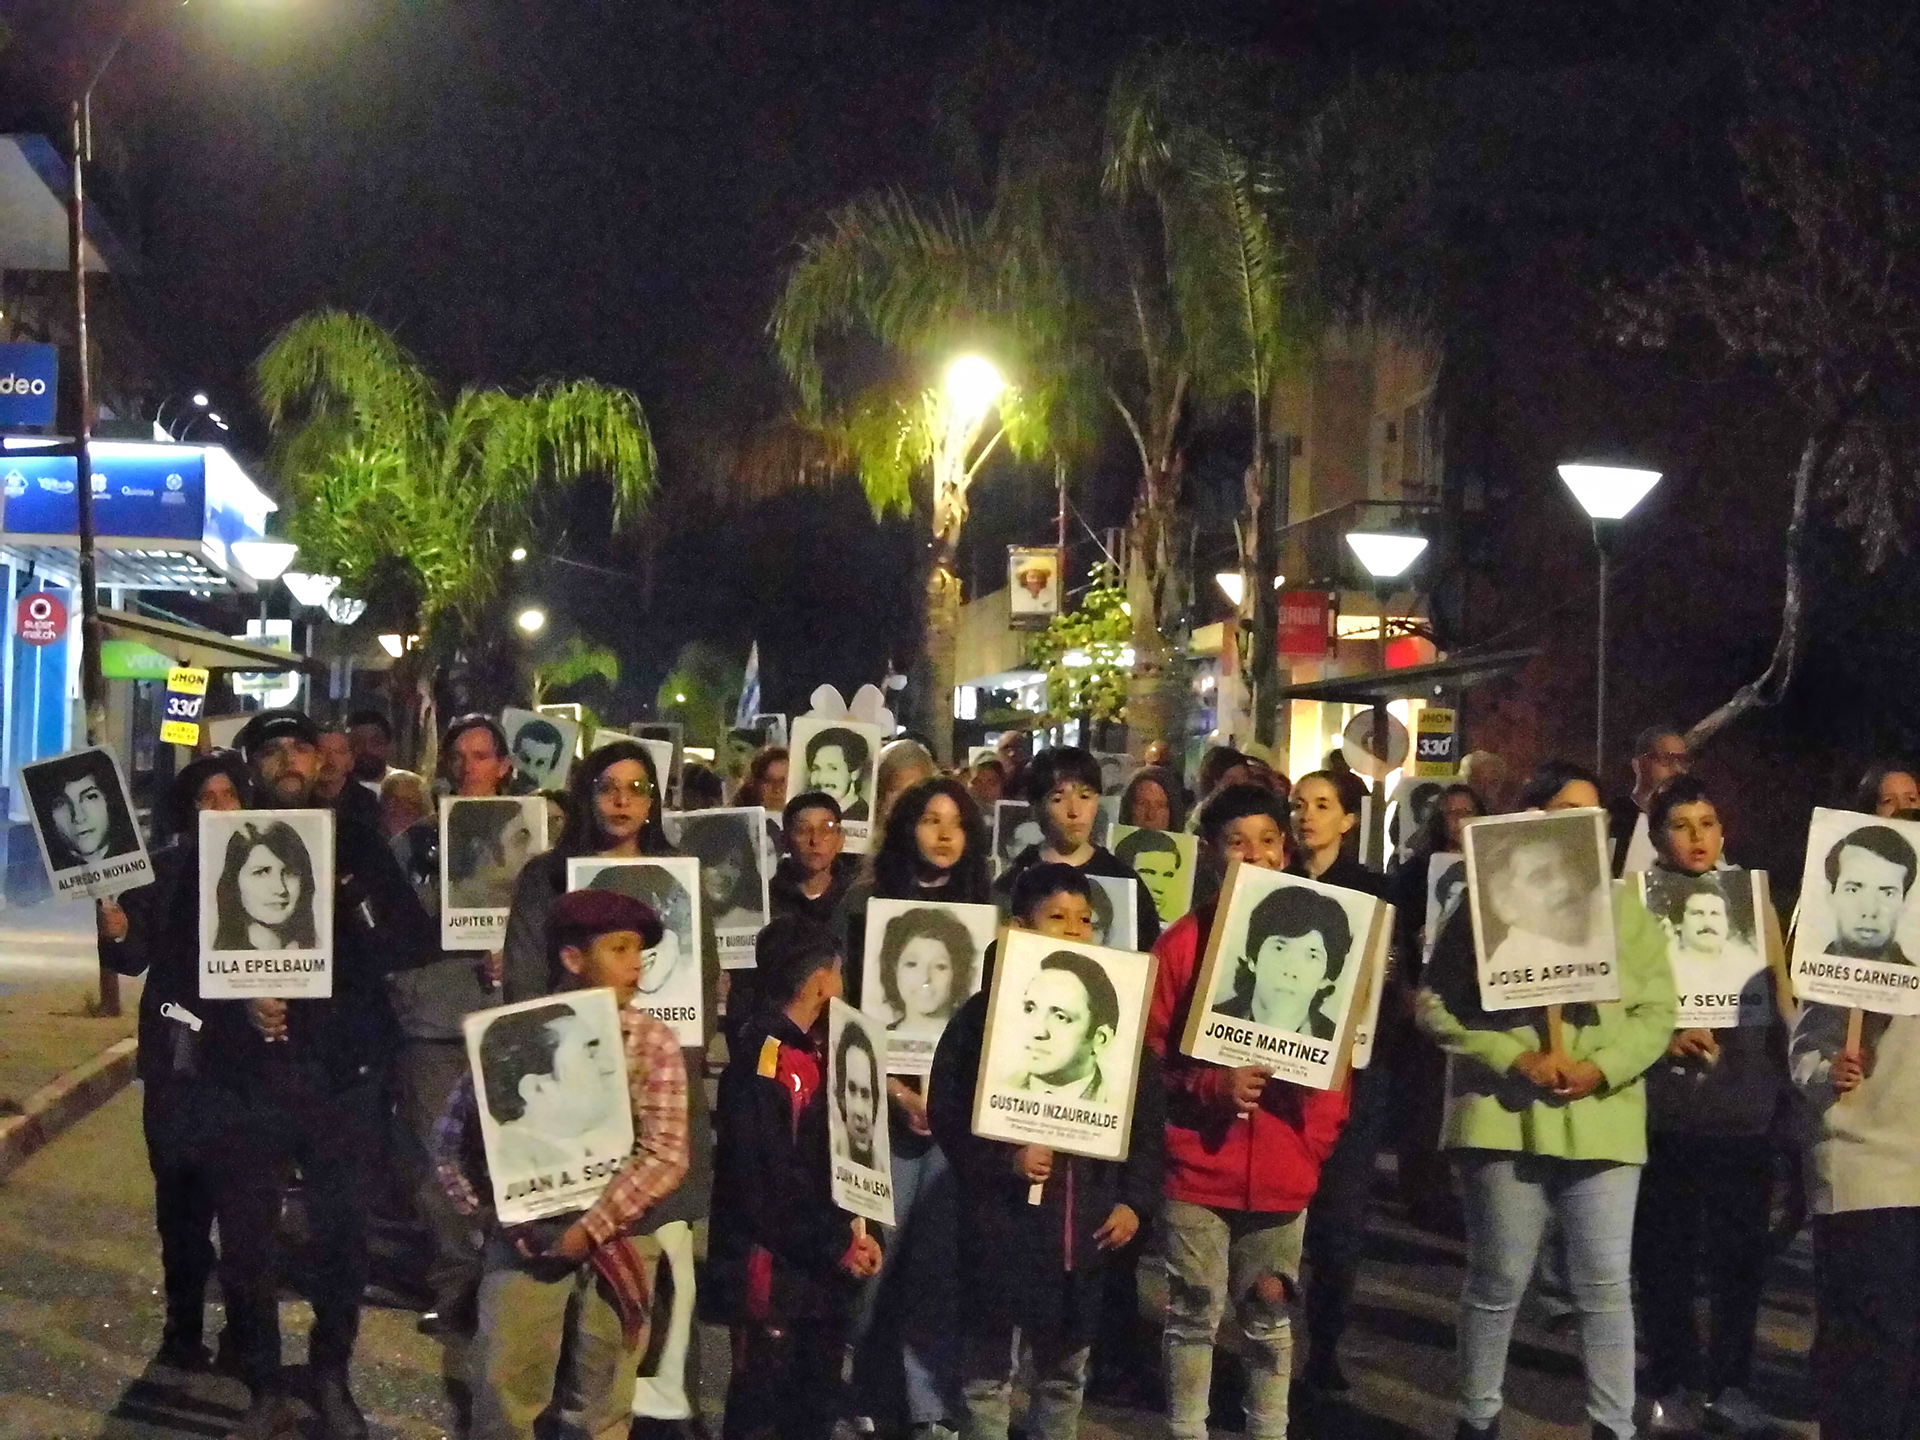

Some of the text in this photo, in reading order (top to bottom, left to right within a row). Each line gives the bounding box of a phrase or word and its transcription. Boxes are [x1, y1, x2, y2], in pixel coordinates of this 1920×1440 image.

[0, 372, 46, 395] deo
[58, 870, 101, 891] ALFREDO
[102, 858, 147, 879] MOYANO
[449, 915, 494, 927] JUPITER
[207, 959, 325, 974] LILA EPELBAUM
[1854, 968, 1919, 990] CARNEIRO
[640, 1006, 696, 1021] RSBERG
[1205, 1022, 1254, 1046] JORGE
[989, 1094, 1040, 1116] GUSTAVO
[1042, 1103, 1119, 1129] INZAURRALDE
